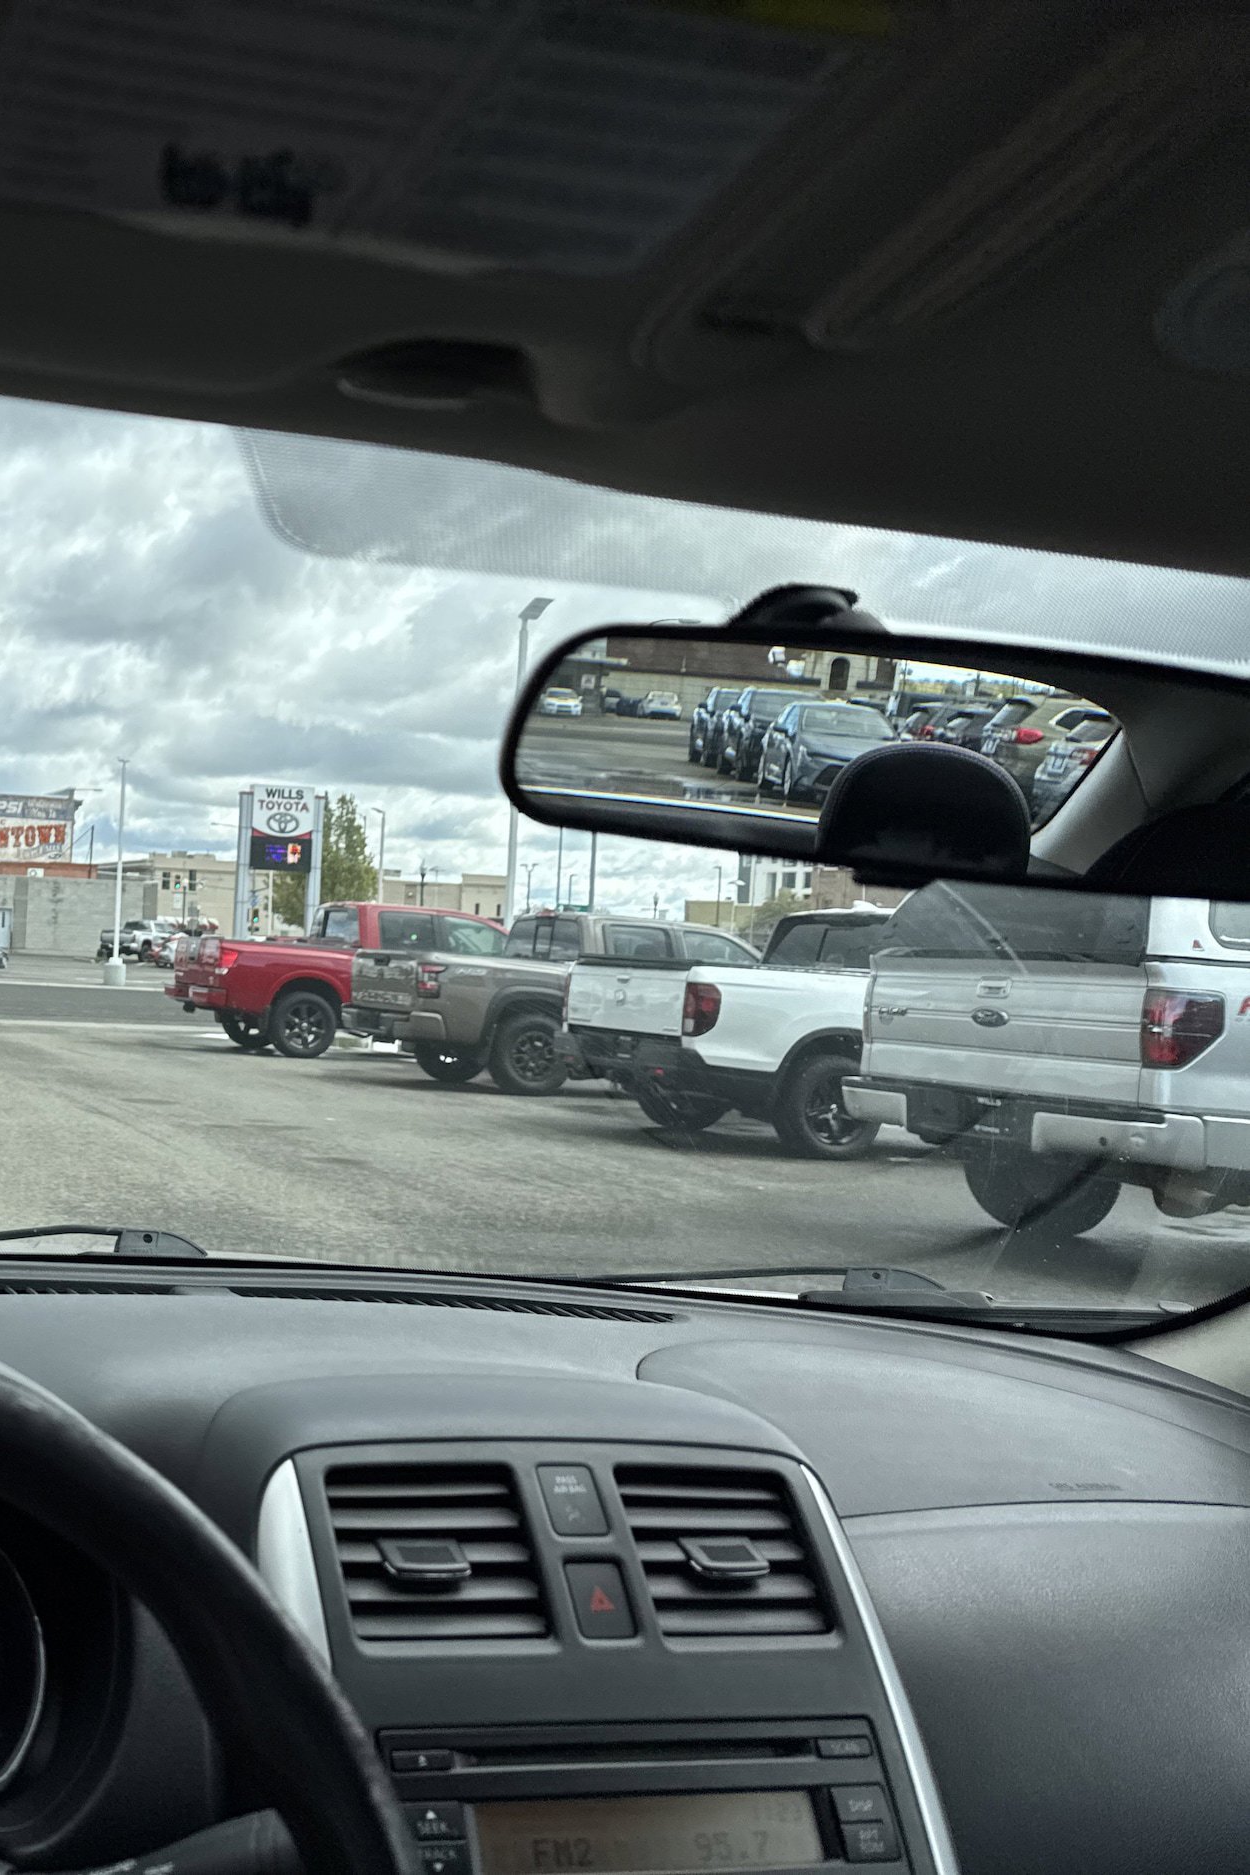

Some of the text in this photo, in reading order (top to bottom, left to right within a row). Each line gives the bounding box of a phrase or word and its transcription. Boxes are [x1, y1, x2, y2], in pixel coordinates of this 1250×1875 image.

[265, 788, 304, 800] WILLS
[258, 799, 310, 812] TOYOTA
[533, 1832, 768, 1868] FM2 95.7
